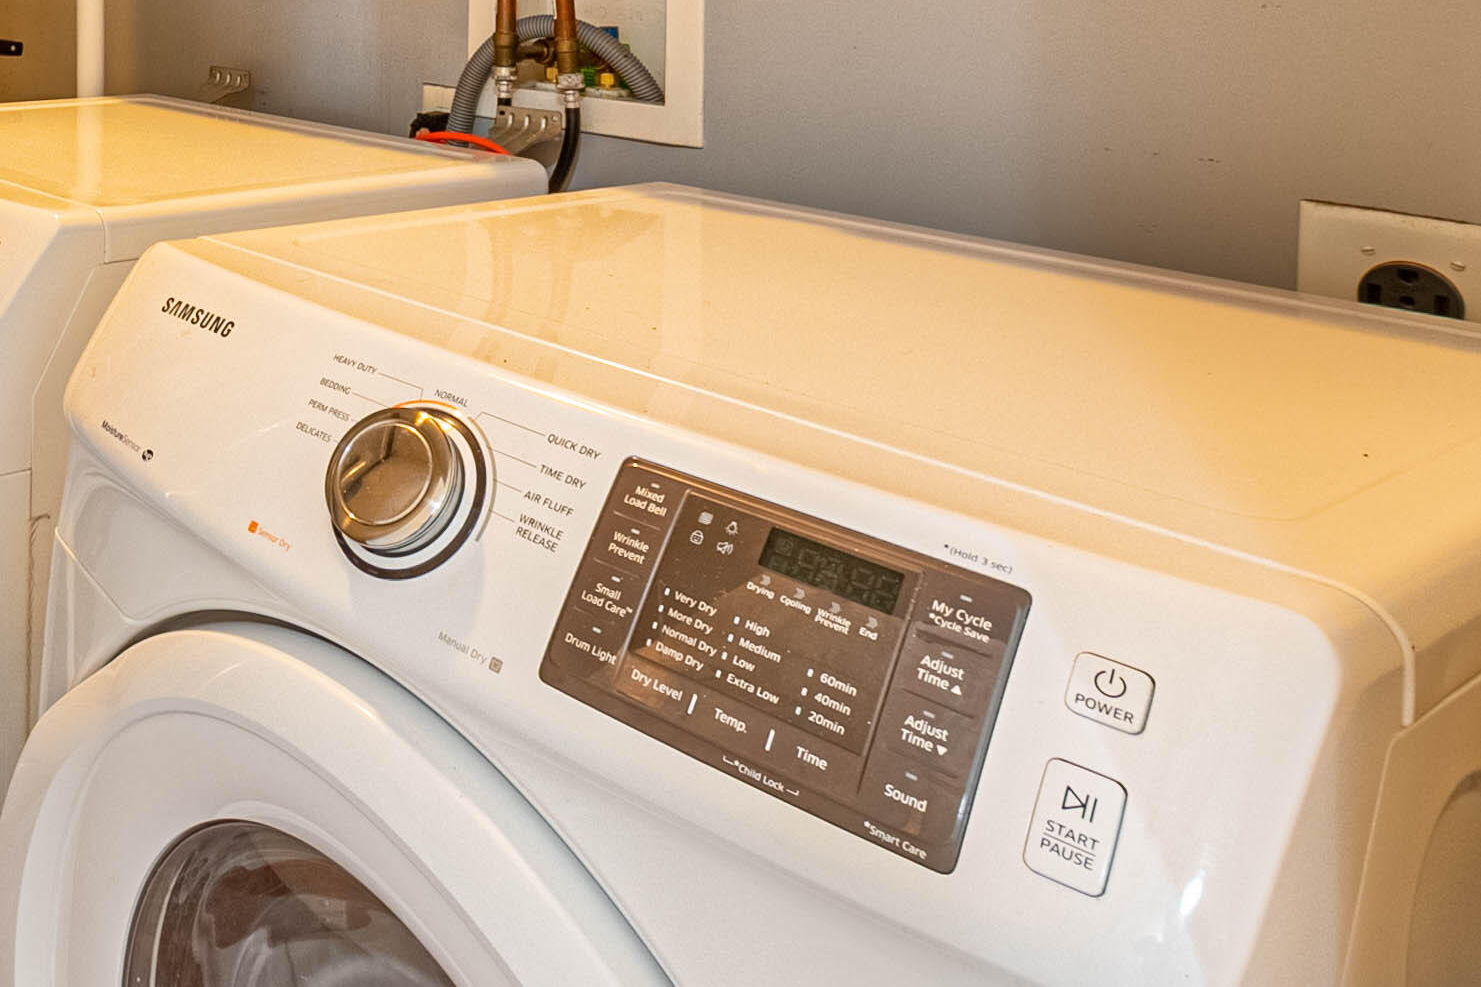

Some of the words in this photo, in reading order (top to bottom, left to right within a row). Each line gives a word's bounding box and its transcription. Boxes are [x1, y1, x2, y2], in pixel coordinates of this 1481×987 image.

[161, 297, 235, 338] SAMSUNG
[333, 353, 357, 367] HEAVY
[357, 362, 378, 374] DUTY
[320, 377, 352, 395] BEDDING
[434, 388, 469, 407] NORMAL
[308, 398, 328, 413] PERM
[328, 406, 350, 422] PRESS
[296, 421, 332, 443] DELICATES
[547, 433, 578, 452] QUICK
[578, 445, 601, 460] DRY
[540, 464, 563, 481] TIME
[564, 475, 587, 490] DRY
[524, 490, 542, 505] AIR
[542, 497, 575, 517] FLUFF
[623, 493, 647, 510] Load
[647, 502, 668, 517] Bell
[635, 485, 665, 504] Mixed
[515, 526, 559, 553] RELEASE
[519, 513, 564, 541] WRINKLE
[608, 542, 646, 565] Prevent
[613, 530, 650, 554] Wrinkle
[981, 555, 989, 567] 3
[991, 560, 1013, 574] sec)
[581, 590, 605, 608] Load
[595, 582, 622, 601] Small
[746, 581, 775, 600] Drying
[675, 590, 697, 608] Very
[695, 601, 718, 617] Dry
[779, 594, 812, 615] Cooling
[931, 598, 953, 620] My
[955, 609, 993, 631] Cycle
[667, 607, 693, 625] More
[694, 617, 714, 634] Dry
[744, 619, 771, 638] High
[814, 615, 850, 635] Prevent
[818, 607, 852, 626] Wrinkle
[661, 623, 696, 647] Normal
[696, 639, 718, 657] Dry
[859, 626, 879, 641] End
[963, 626, 991, 644] Save
[437, 631, 470, 654] Manual
[470, 646, 488, 665] Dry
[564, 631, 592, 652] Drum
[591, 644, 618, 666] Light
[655, 641, 684, 662] Damp
[683, 653, 705, 671] Dry
[738, 637, 782, 663] Medium
[732, 654, 756, 673] Low
[920, 654, 965, 681] Adjust
[630, 668, 652, 687] Dry
[652, 679, 683, 701] Level
[726, 673, 755, 695] Extra
[755, 686, 780, 704] Low
[819, 672, 858, 697] 60min
[917, 667, 950, 692] Time
[813, 691, 852, 717] 40min
[1075, 693, 1135, 724] POWER
[713, 707, 748, 734] Temp.
[807, 710, 846, 735] 20min
[904, 715, 949, 742] Adjust
[900, 728, 933, 753] Time
[796, 745, 828, 771] Time
[763, 771, 785, 793] Lock
[884, 783, 928, 813] Sound
[1046, 819, 1100, 851] START
[902, 839, 928, 860] Care
[1040, 837, 1096, 871] PAUSE
